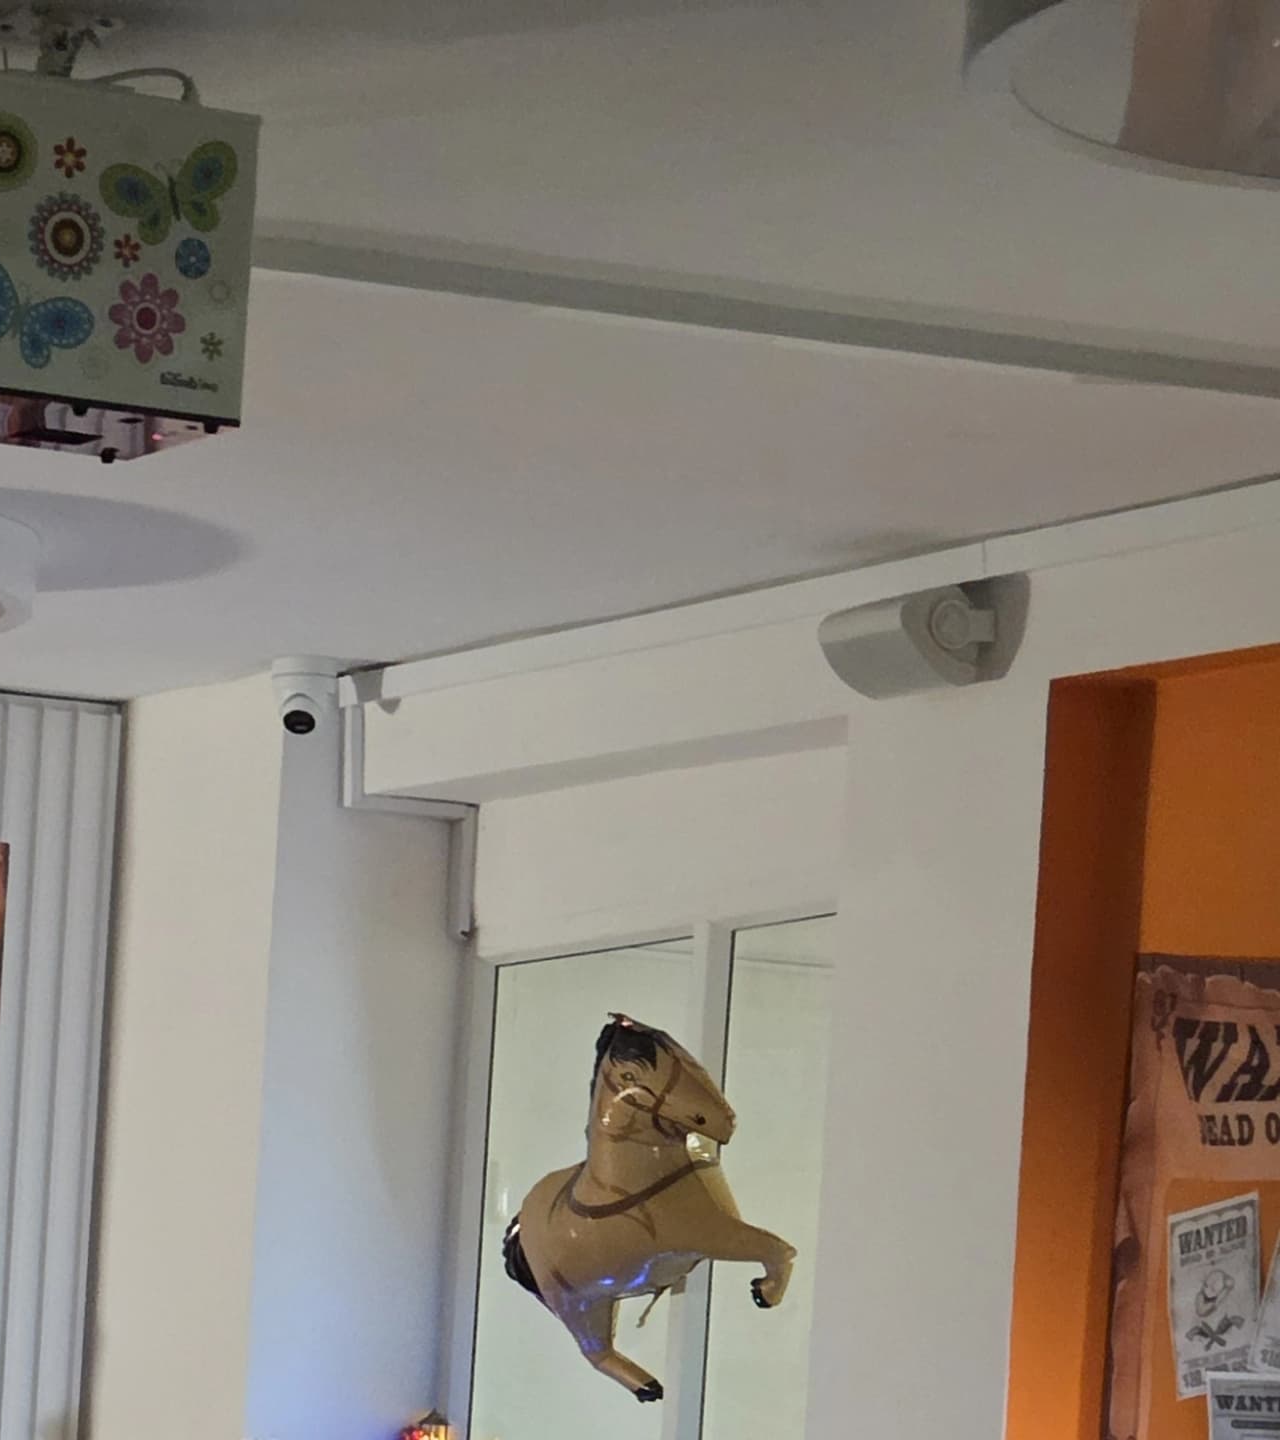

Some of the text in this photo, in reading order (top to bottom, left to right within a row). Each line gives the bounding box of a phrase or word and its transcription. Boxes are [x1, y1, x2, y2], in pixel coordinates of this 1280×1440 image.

[1173, 1017, 1280, 1103] WA
[1198, 1113, 1255, 1147] EAD
[1178, 1215, 1247, 1256] WANTED
